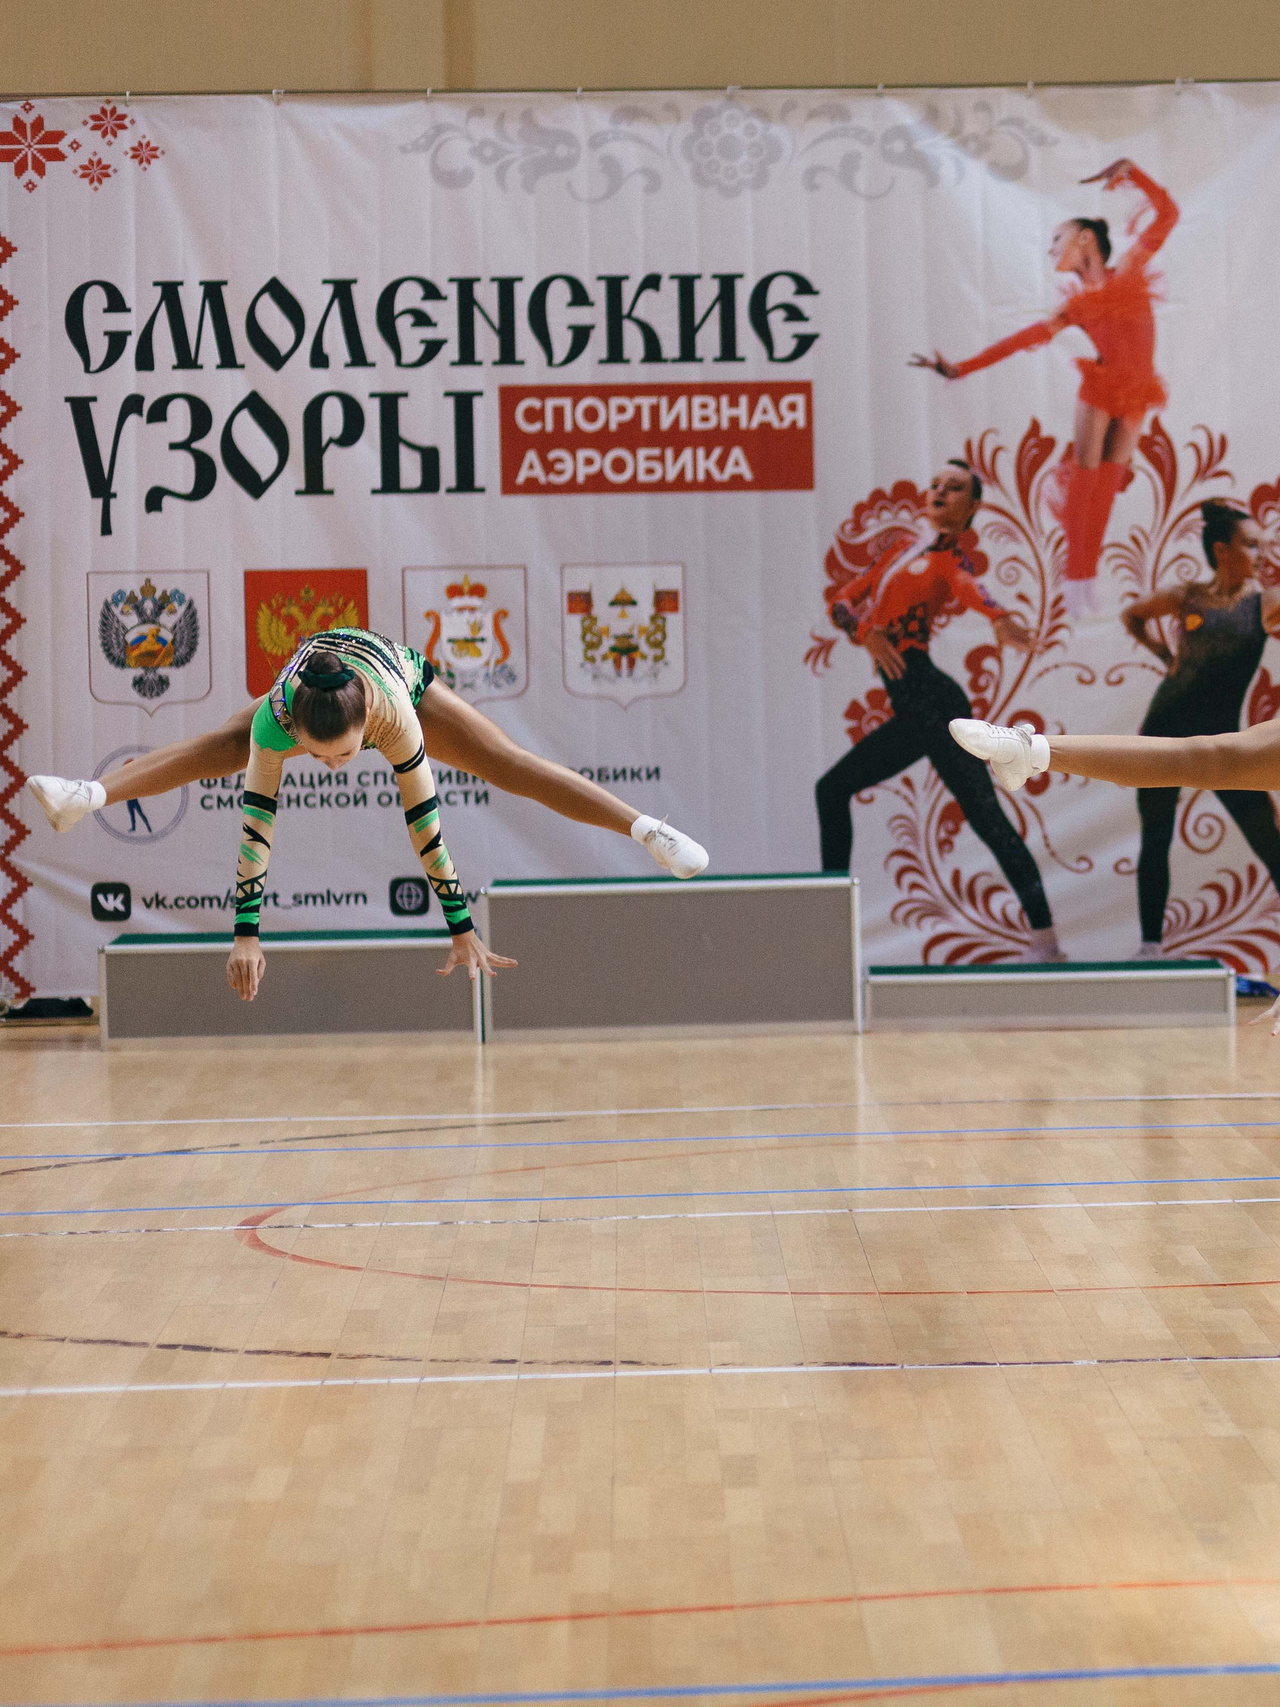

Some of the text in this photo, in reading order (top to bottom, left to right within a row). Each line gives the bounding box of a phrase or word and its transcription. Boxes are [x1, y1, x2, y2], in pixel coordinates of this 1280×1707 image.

[64, 270, 821, 374] СМОЛЕНСКИЕ
[515, 394, 806, 434] СПОРТИВНАЯ
[64, 389, 486, 536] УЗОРЫ
[516, 446, 754, 484] АЭРОБИКА
[200, 769, 348, 792] ФЕДАЦИЯ
[570, 765, 662, 784] ОБИКИ
[200, 788, 490, 811] СМОЕНСКОЙ ОСТИ
[142, 888, 368, 910] vk.com/srt_smlvrn
